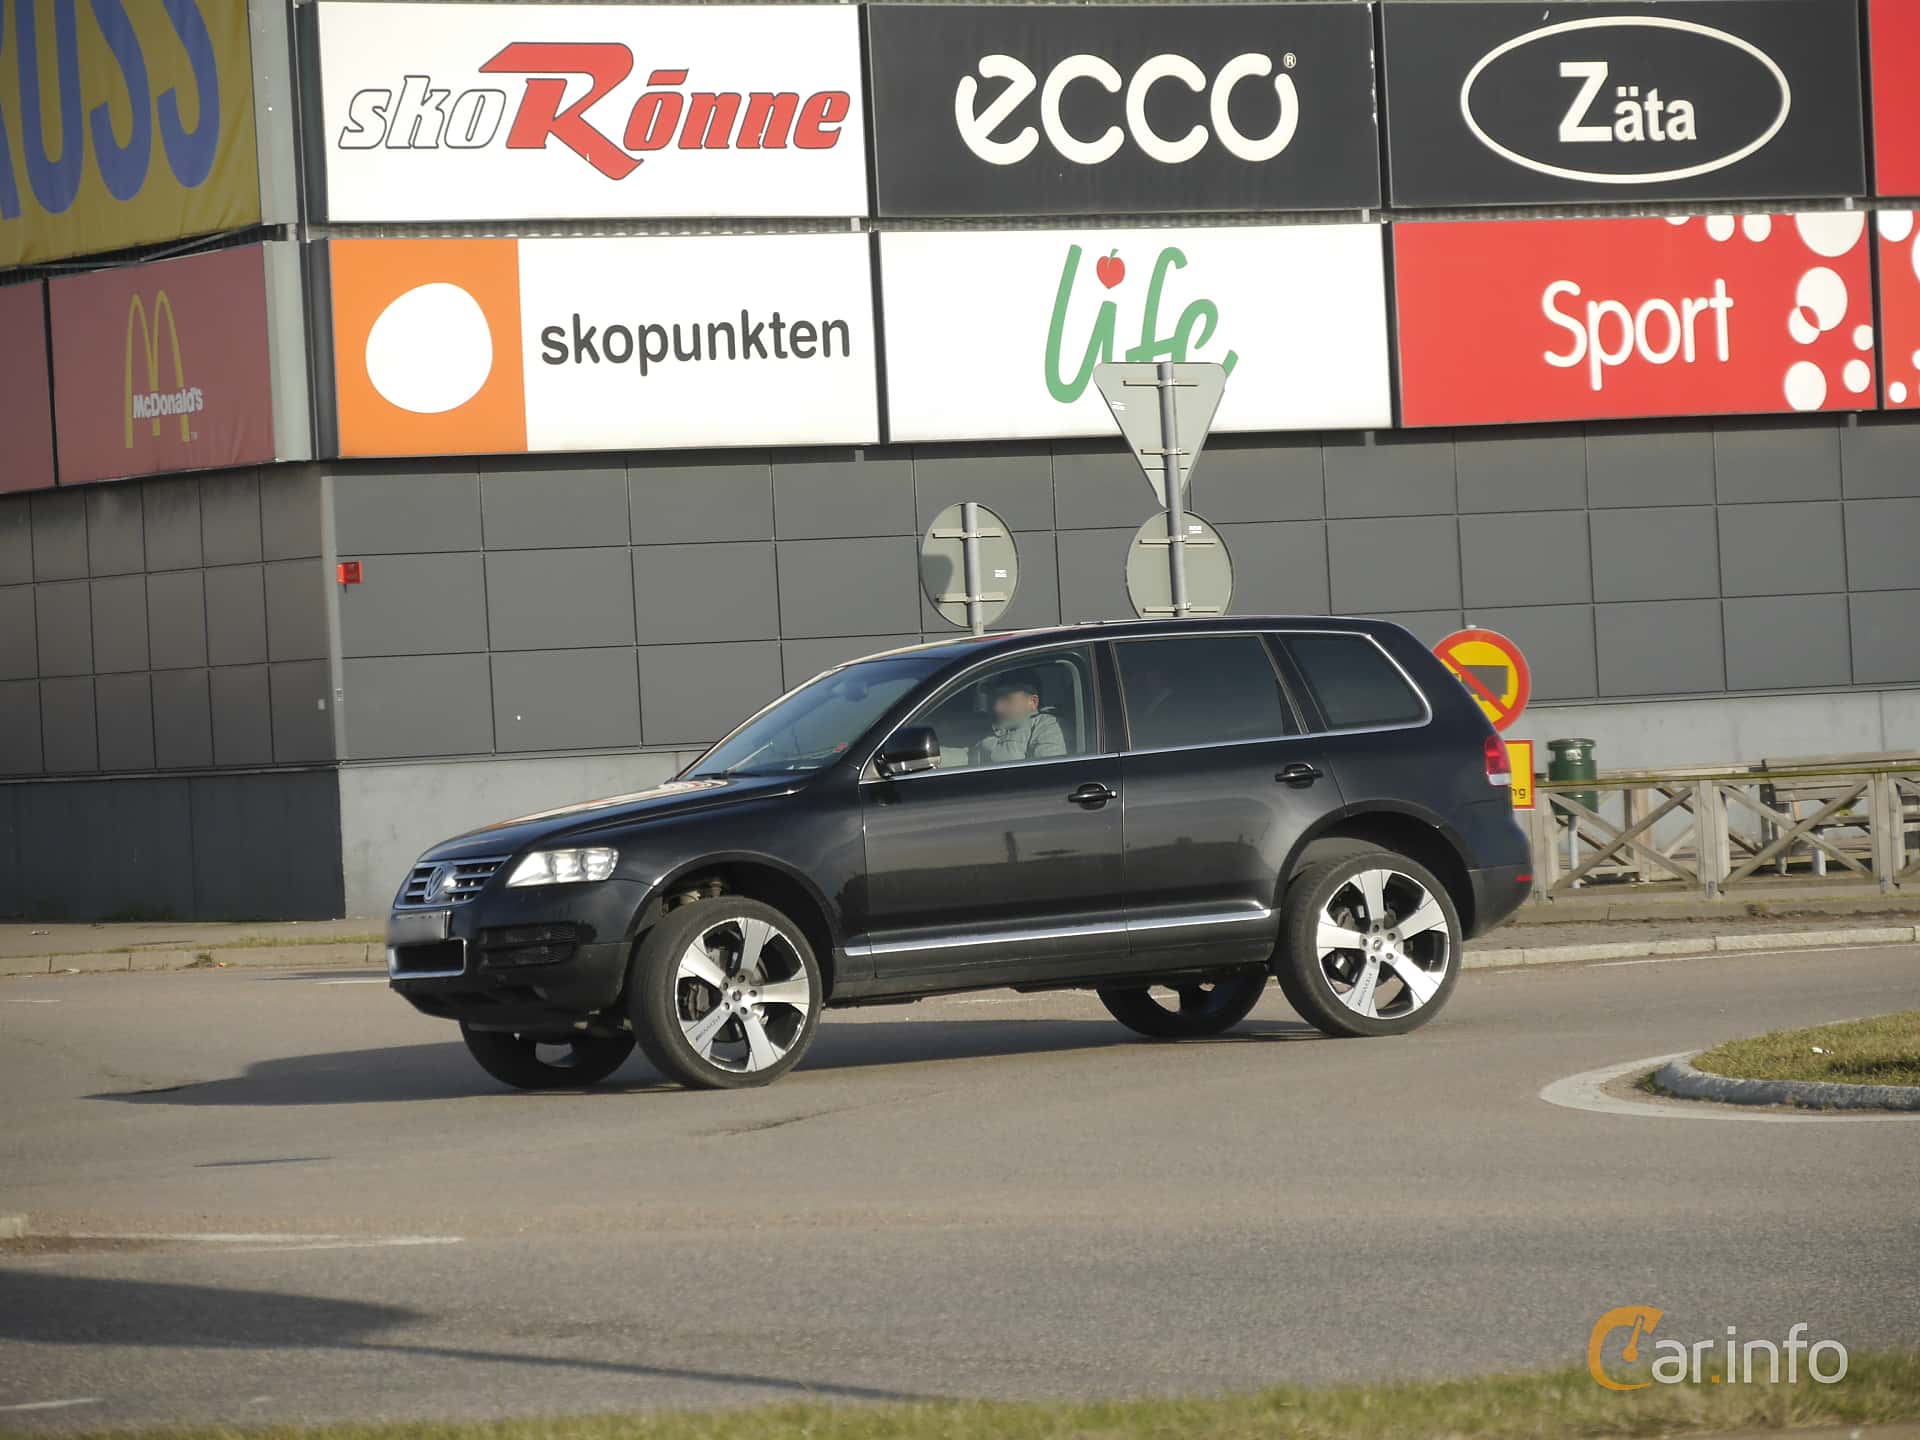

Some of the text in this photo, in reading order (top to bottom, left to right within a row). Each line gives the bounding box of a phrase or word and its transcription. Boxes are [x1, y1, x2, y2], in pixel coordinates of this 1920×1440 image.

[0, 0, 221, 220] USS
[955, 52, 1299, 165] ecco
[1558, 61, 1697, 142] Zäta
[540, 308, 851, 377] skopunkten
[1541, 278, 1735, 392] Sport
[133, 386, 203, 419] McDonald's
